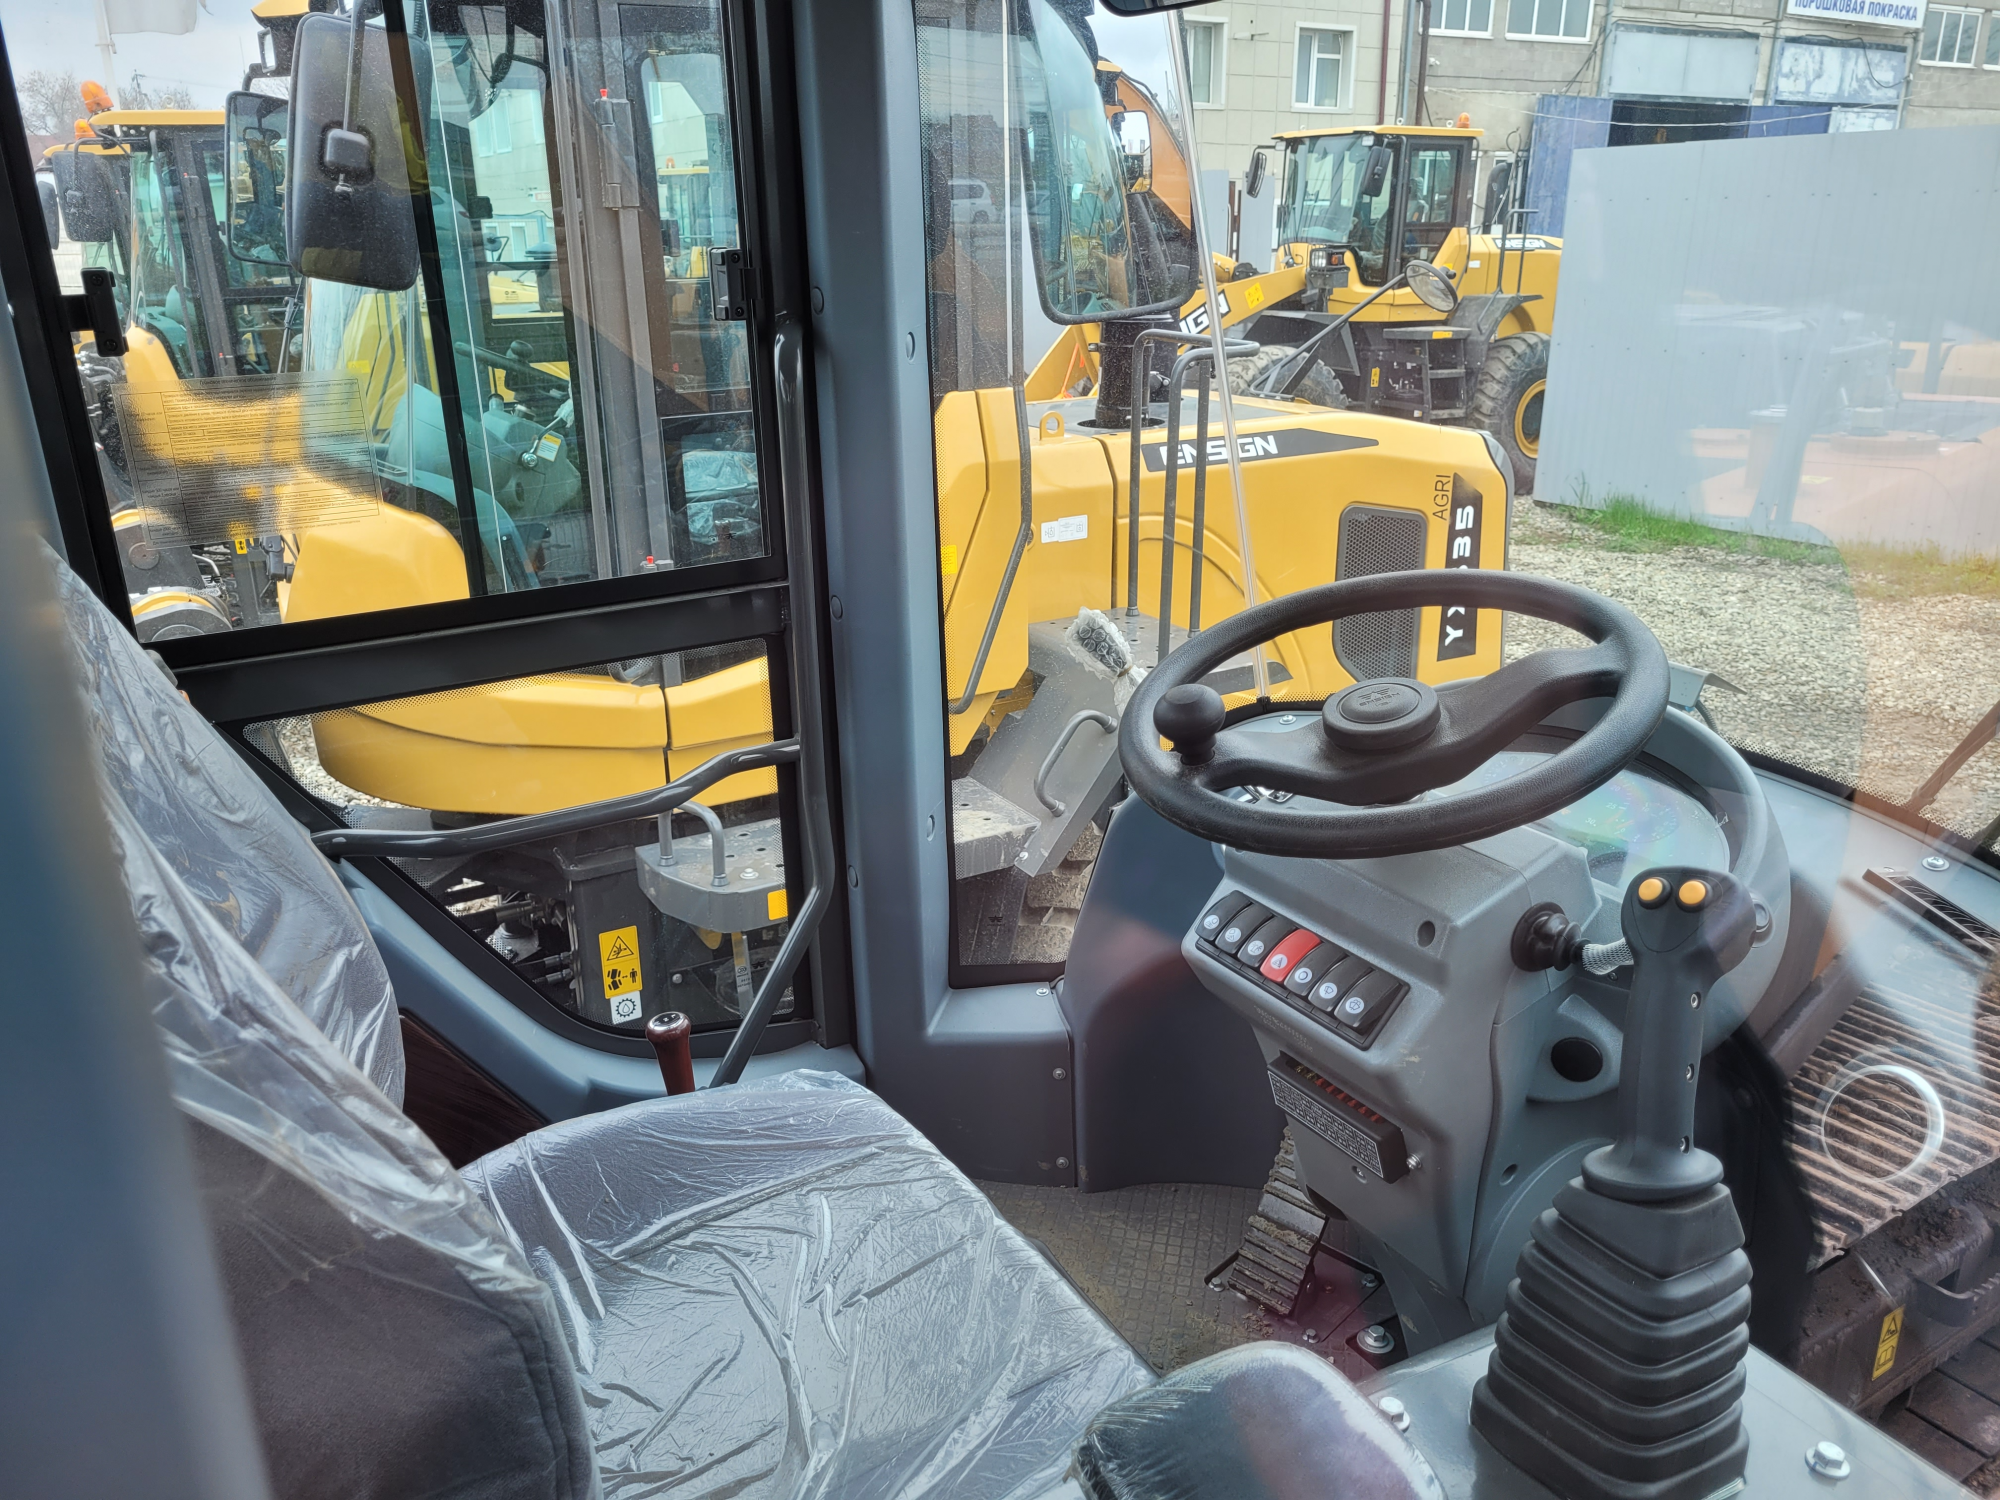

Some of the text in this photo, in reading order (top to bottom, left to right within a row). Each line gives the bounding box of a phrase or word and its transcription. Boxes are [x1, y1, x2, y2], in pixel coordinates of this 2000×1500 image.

[1794, 0, 1918, 21] ПОРОШКОВАЯ ПОКРАСКА
[1432, 474, 1452, 522] AGRI
[1444, 504, 1475, 647] YX35
